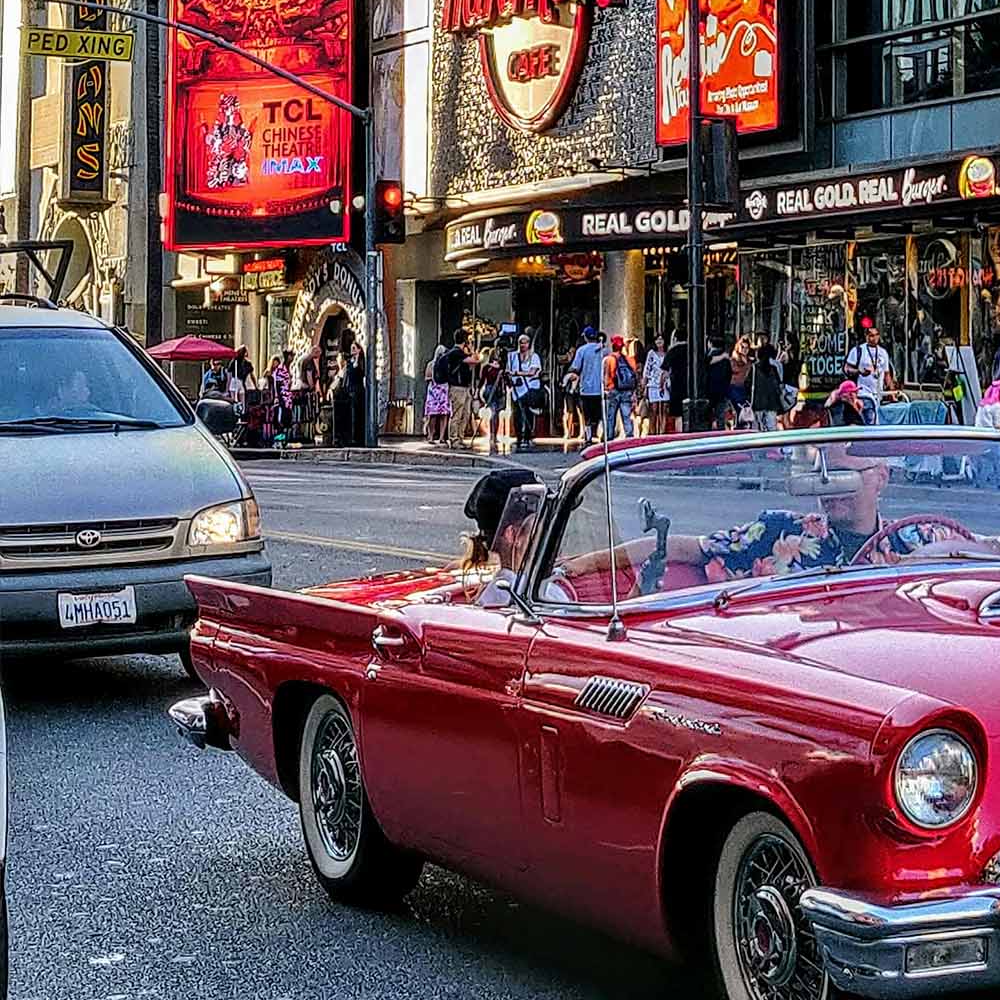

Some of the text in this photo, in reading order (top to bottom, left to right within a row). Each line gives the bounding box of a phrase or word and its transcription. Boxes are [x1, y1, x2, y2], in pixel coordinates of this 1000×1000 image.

[28, 32, 125, 56] PED XING
[507, 45, 562, 84] CAFE
[262, 98, 323, 124] TCL
[262, 124, 322, 143] CHINESE
[261, 156, 324, 176] IMAX
[776, 190, 812, 215] REAL
[859, 177, 898, 203] REAL
[581, 211, 632, 235] REAL
[330, 242, 348, 252] TCL
[65, 600, 131, 624] 4MHA051
